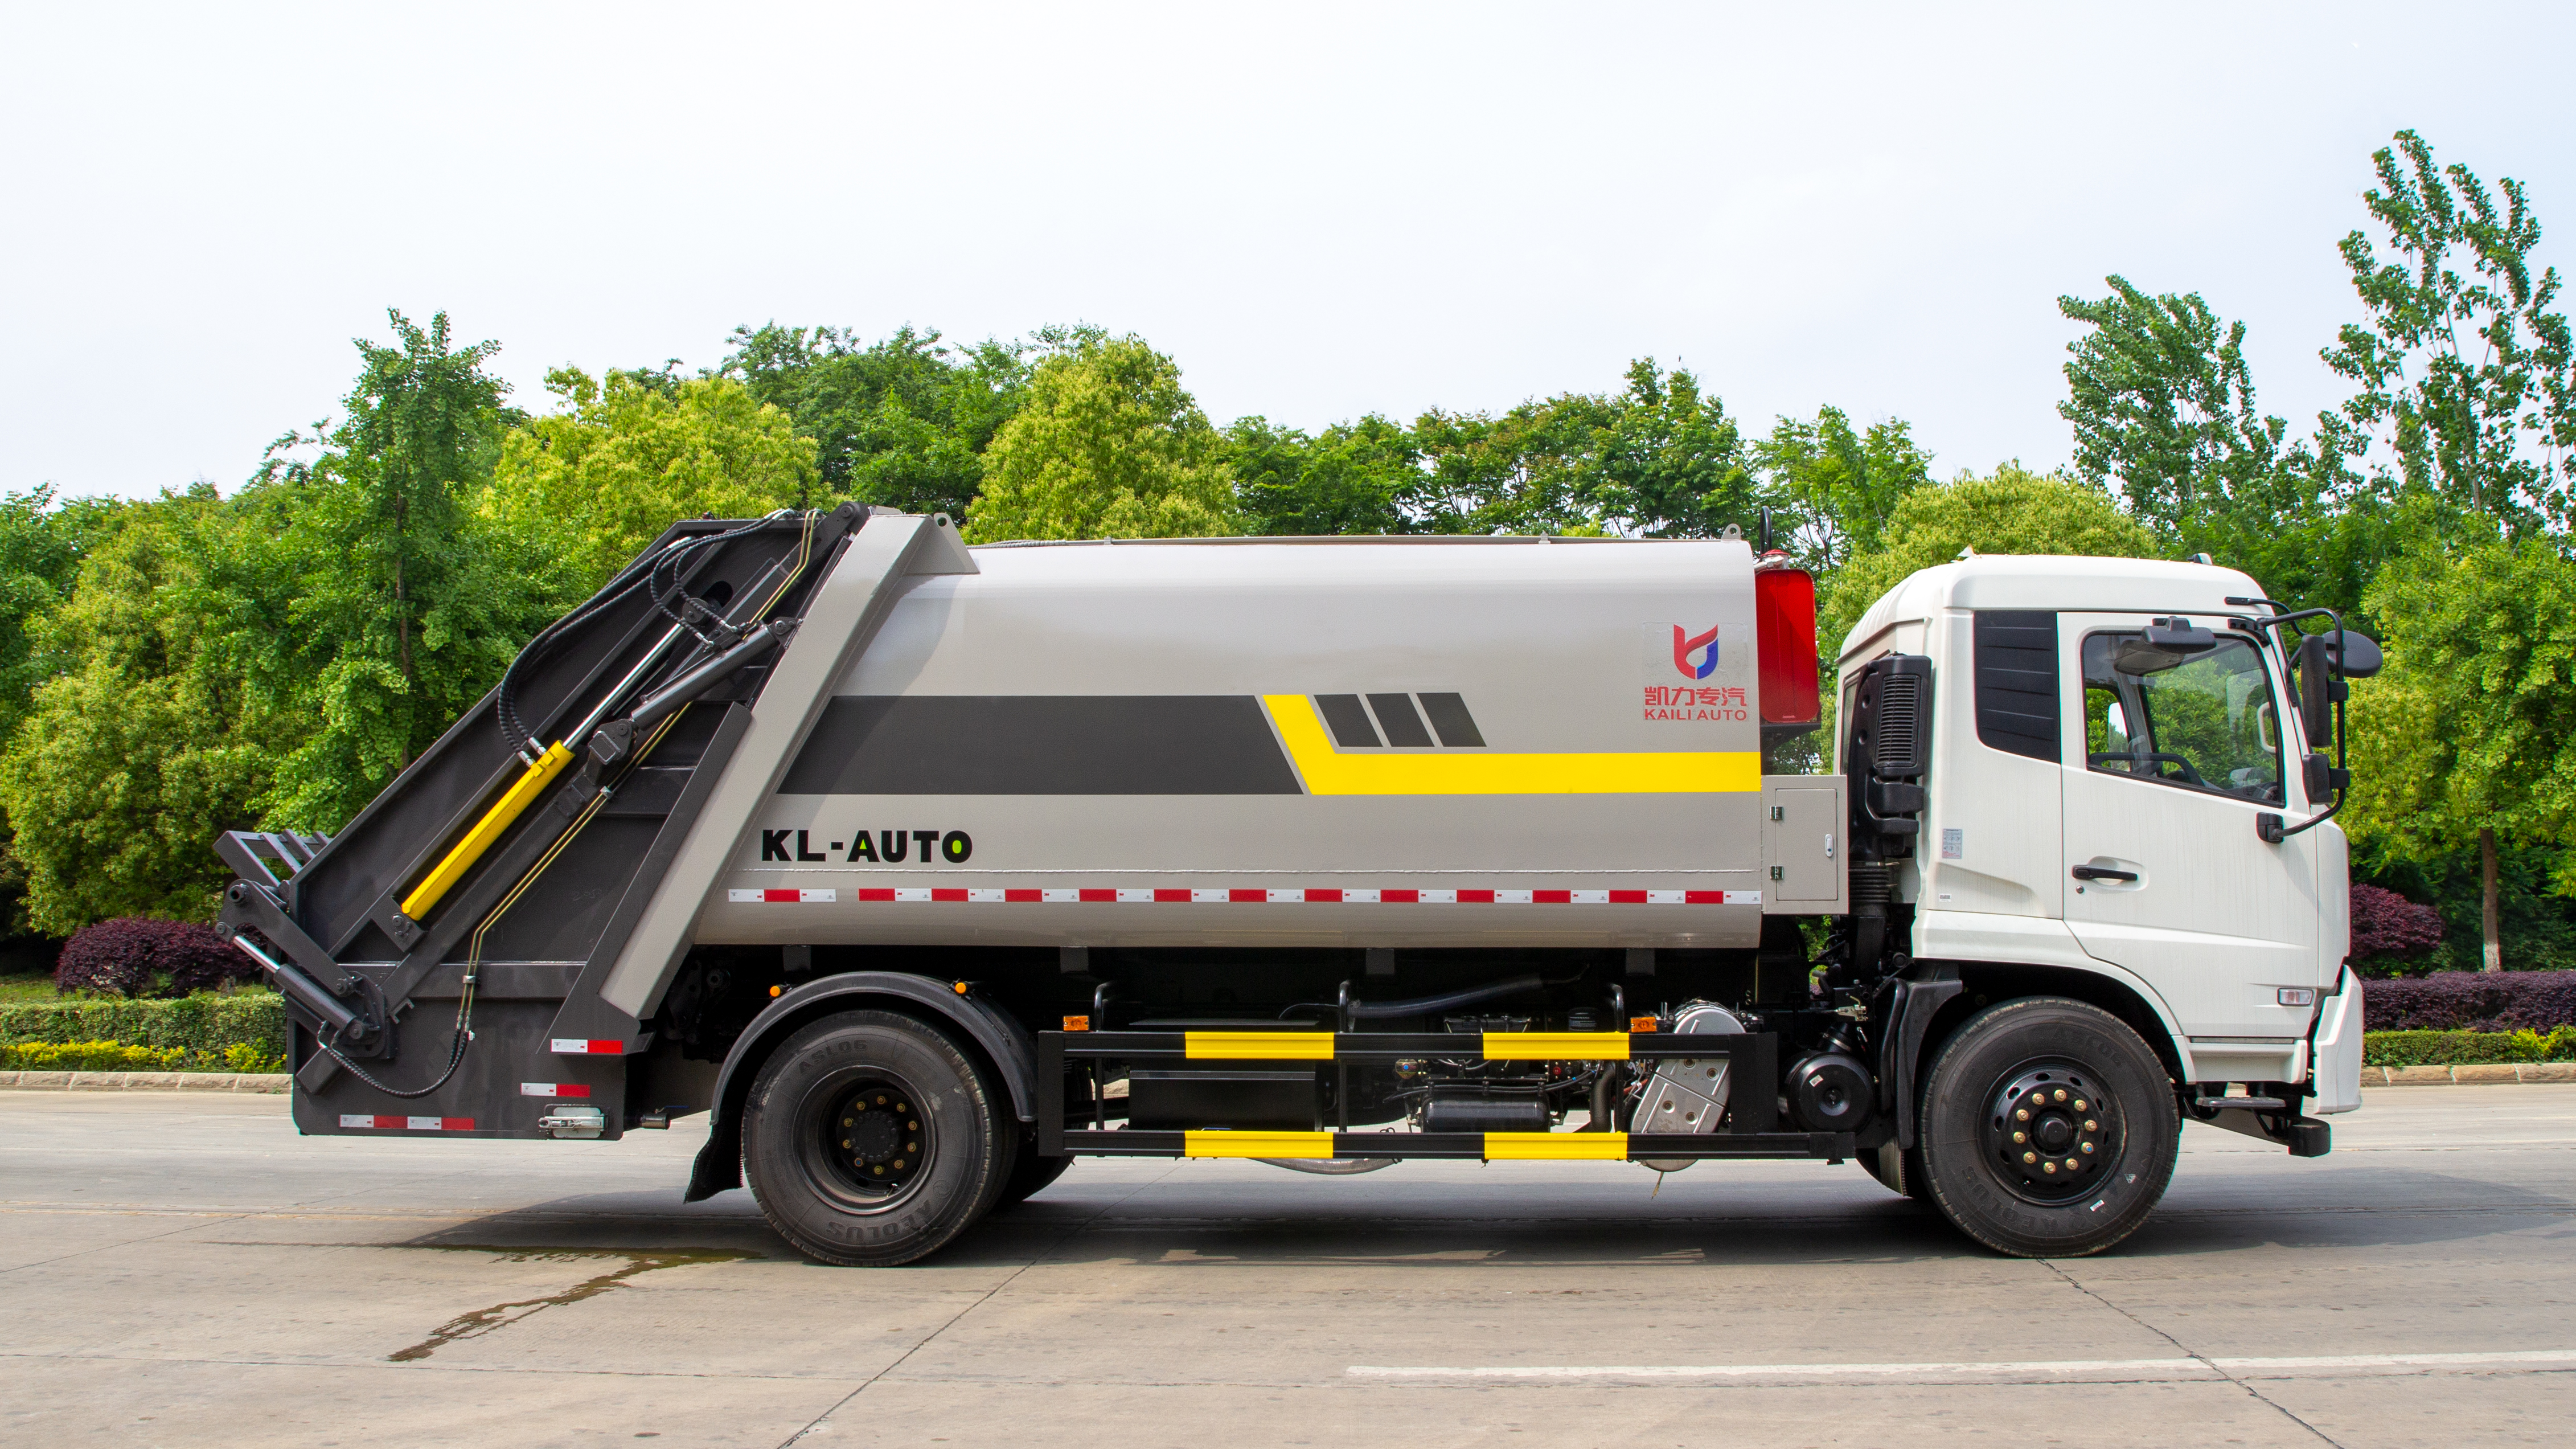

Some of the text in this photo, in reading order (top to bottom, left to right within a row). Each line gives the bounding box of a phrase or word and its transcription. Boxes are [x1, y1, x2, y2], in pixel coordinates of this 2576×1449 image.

[1644, 686, 1747, 706] 凯力专汽
[1644, 709, 1747, 721] KAILI AUTO
[761, 829, 973, 863] KL-AUTO
[826, 1199, 932, 1244] AEOLUS
